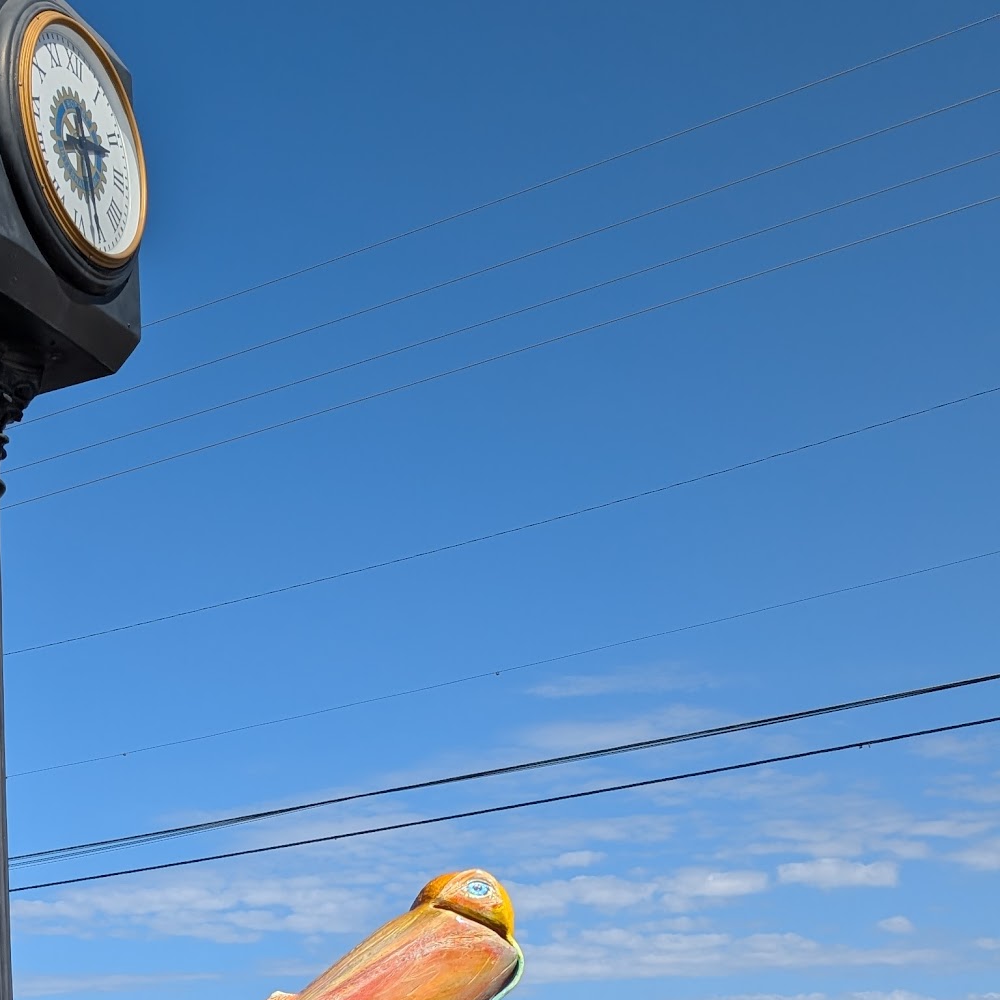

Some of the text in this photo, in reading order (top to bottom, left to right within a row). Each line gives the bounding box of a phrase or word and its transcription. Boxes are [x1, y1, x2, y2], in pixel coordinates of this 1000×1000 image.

[44, 42, 62, 69] XI
[64, 47, 84, 83] XII
[112, 166, 125, 196] III
[106, 196, 123, 234] IIII
